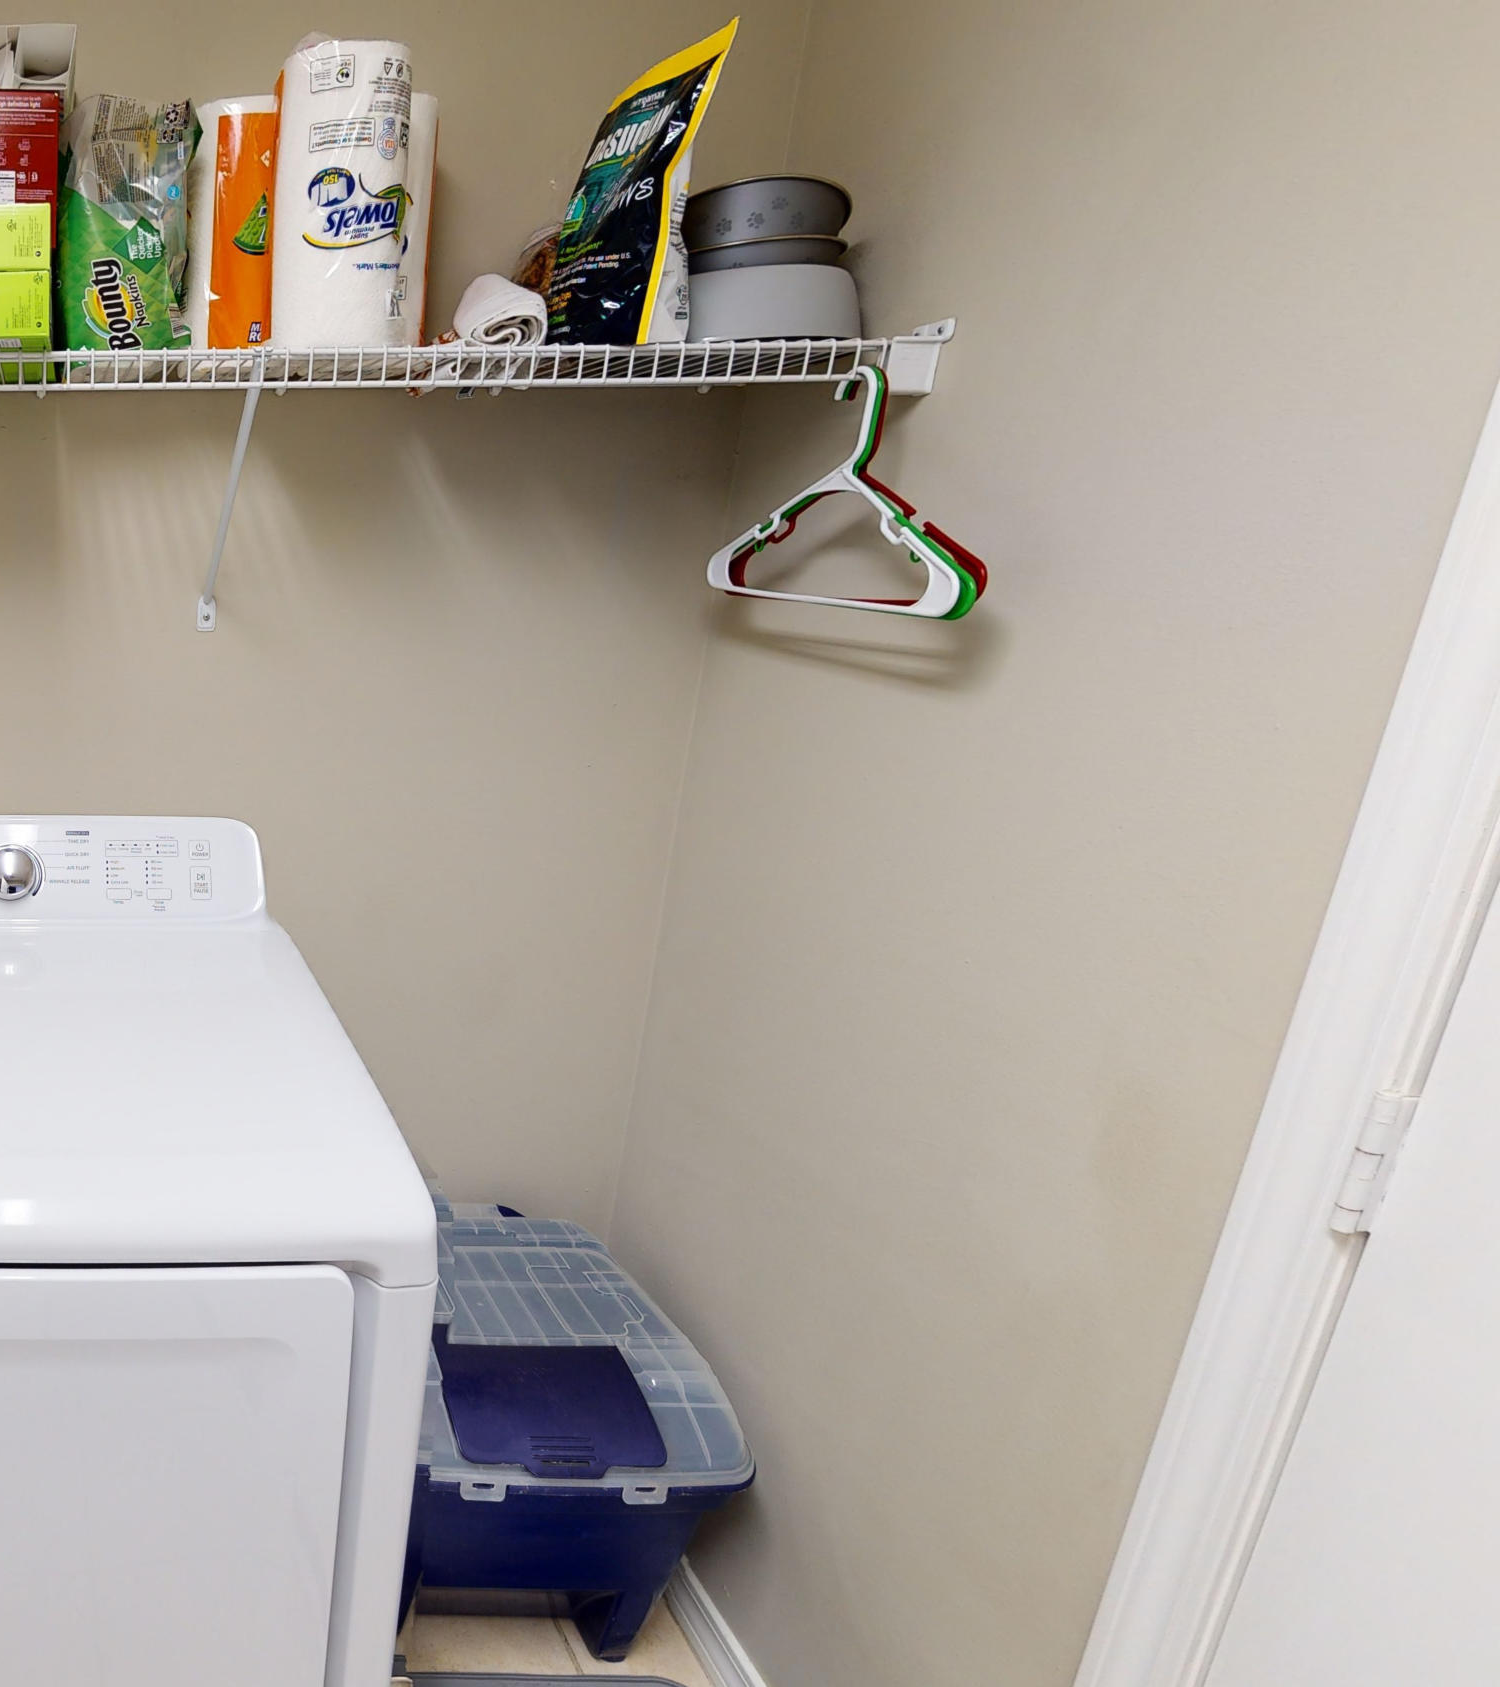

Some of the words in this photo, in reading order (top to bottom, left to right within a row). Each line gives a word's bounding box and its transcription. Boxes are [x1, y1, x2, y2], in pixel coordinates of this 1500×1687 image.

[323, 174, 339, 185] 150
[92, 258, 142, 350] Bounty
[127, 275, 150, 328] Napkins
